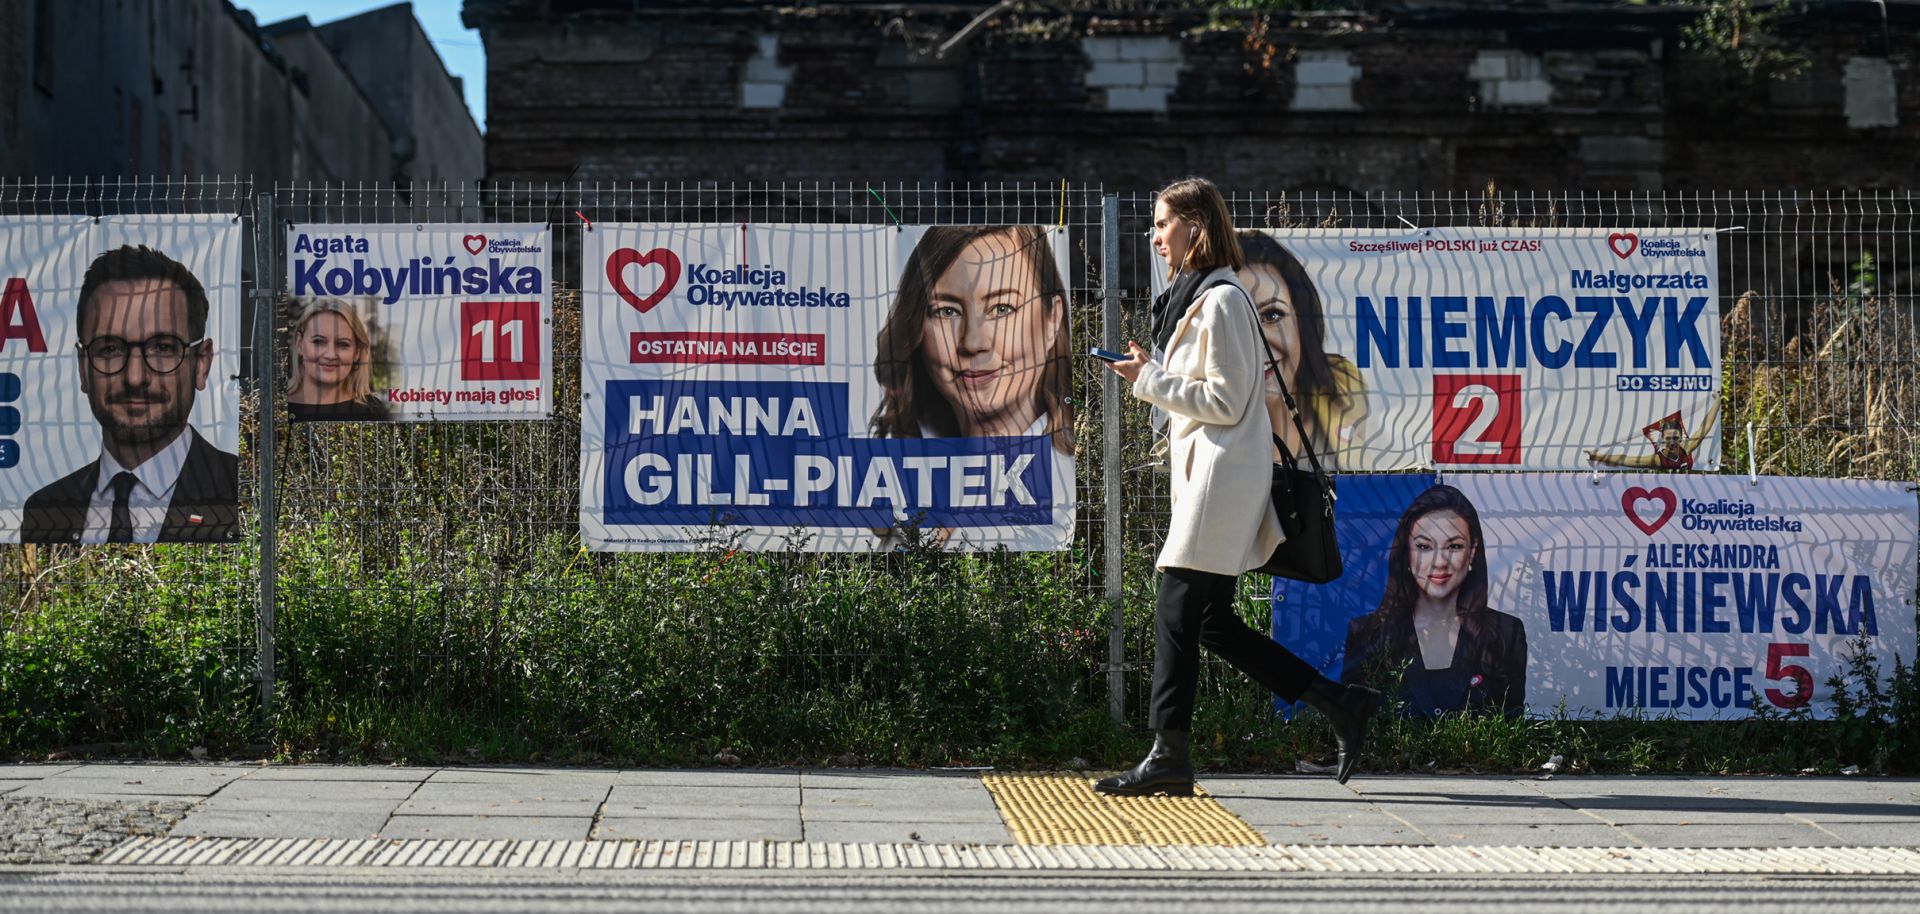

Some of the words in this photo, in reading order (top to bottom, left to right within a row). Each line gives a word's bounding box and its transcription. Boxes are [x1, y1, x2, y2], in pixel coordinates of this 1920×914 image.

[294, 233, 369, 257] Agata
[488, 239, 521, 247] Koalicja
[488, 246, 542, 254] Obywatelska
[1349, 240, 1422, 254] Szczęśliwej
[1425, 240, 1476, 251] POLSKI
[1479, 240, 1498, 253] już
[1501, 240, 1542, 251] CZAS!
[1640, 239, 1681, 249] Koalicja
[1640, 248, 1706, 258] Obywatelska
[294, 256, 542, 305] Kobylińska
[687, 264, 786, 290] Koalicja
[1571, 269, 1709, 293] Małgorzata
[686, 285, 851, 311] Obywatelska
[471, 319, 524, 363] 11
[1355, 296, 1713, 369] NIEMCZYK
[637, 340, 727, 356] OSTATNIA
[732, 342, 759, 356] NA
[762, 337, 818, 357] LIŚCIE
[1618, 376, 1644, 391] DO
[1649, 375, 1711, 391] SEJMU
[387, 388, 452, 405] Kobiety
[455, 387, 496, 405] mają
[499, 387, 541, 405] głos!
[628, 395, 821, 437] HANNA
[1452, 384, 1502, 455] 2
[623, 452, 1037, 521] GILL-PIĄTEK
[1681, 498, 1755, 516] Koalicja
[1681, 514, 1802, 534] Obywatelska
[1645, 543, 1780, 569] ALEKSANDRA
[1543, 554, 1879, 636] WIŚNIEWSKA
[1606, 666, 1753, 709] MIEJSCE
[1764, 642, 1814, 709] 5
